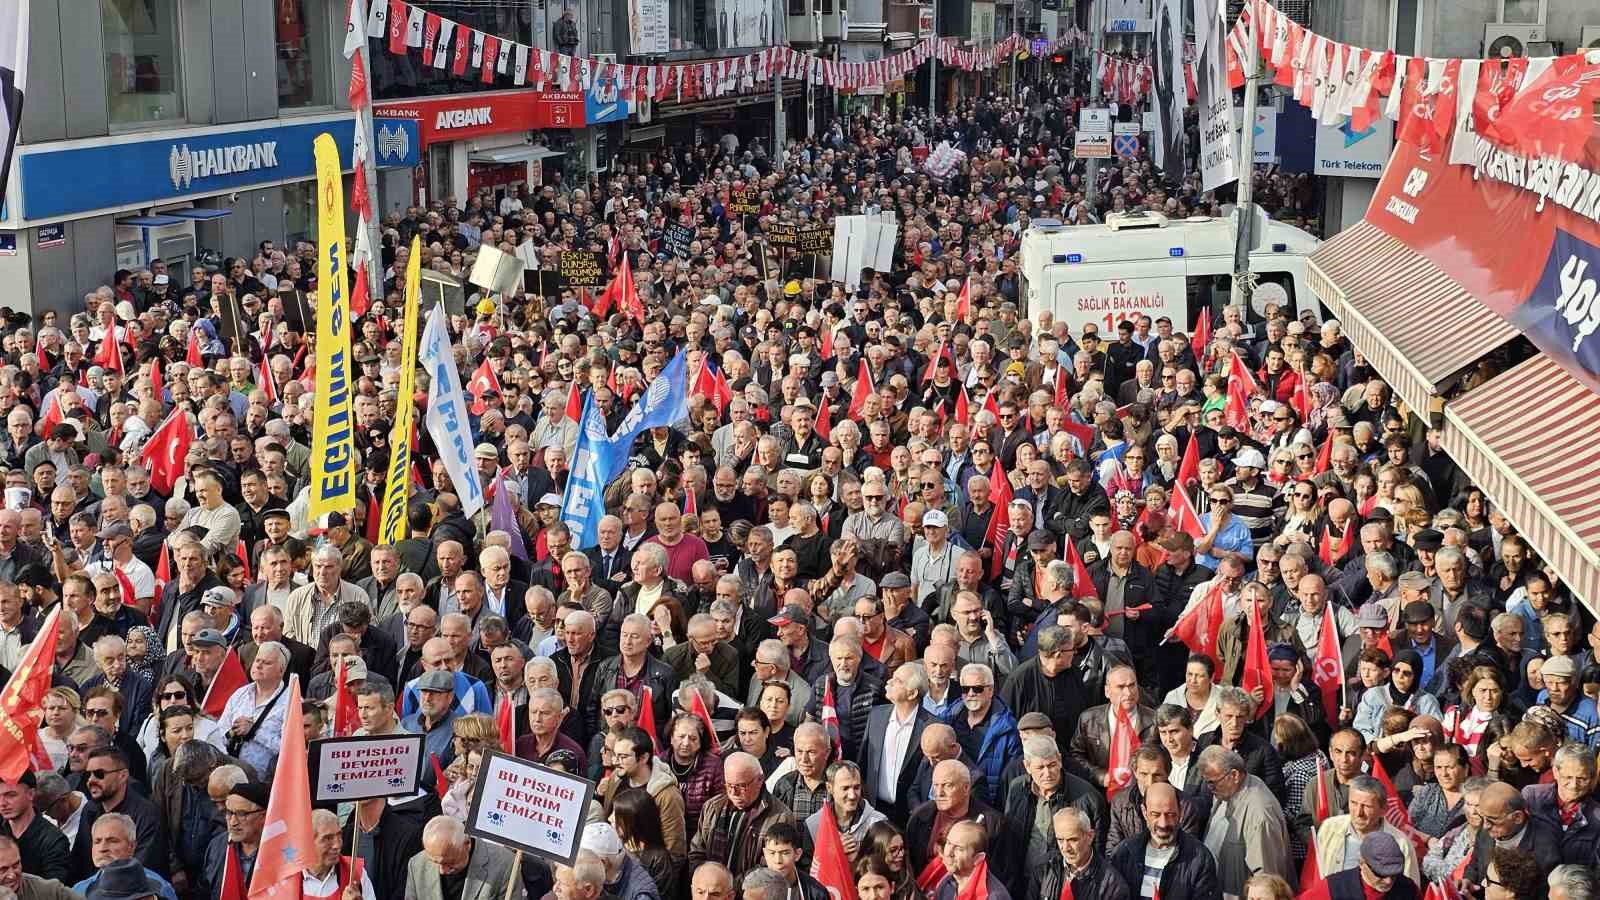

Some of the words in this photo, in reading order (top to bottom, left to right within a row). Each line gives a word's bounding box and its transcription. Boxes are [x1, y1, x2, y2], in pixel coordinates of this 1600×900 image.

[375, 109, 420, 118] AKBANK
[435, 106, 493, 130] AKBANK
[191, 141, 278, 179] HALKBANK
[1321, 159, 1341, 169] Türk
[1343, 160, 1382, 171] Telekom
[1077, 295, 1111, 312] SAĞLIK
[1113, 291, 1165, 310] BAKANLIĞI
[331, 750, 351, 759] BU
[334, 767, 404, 781] TEMİZLER
[498, 769, 518, 784] BU
[487, 810, 506, 822] SOL
[495, 798, 564, 829] TEMİZLER
